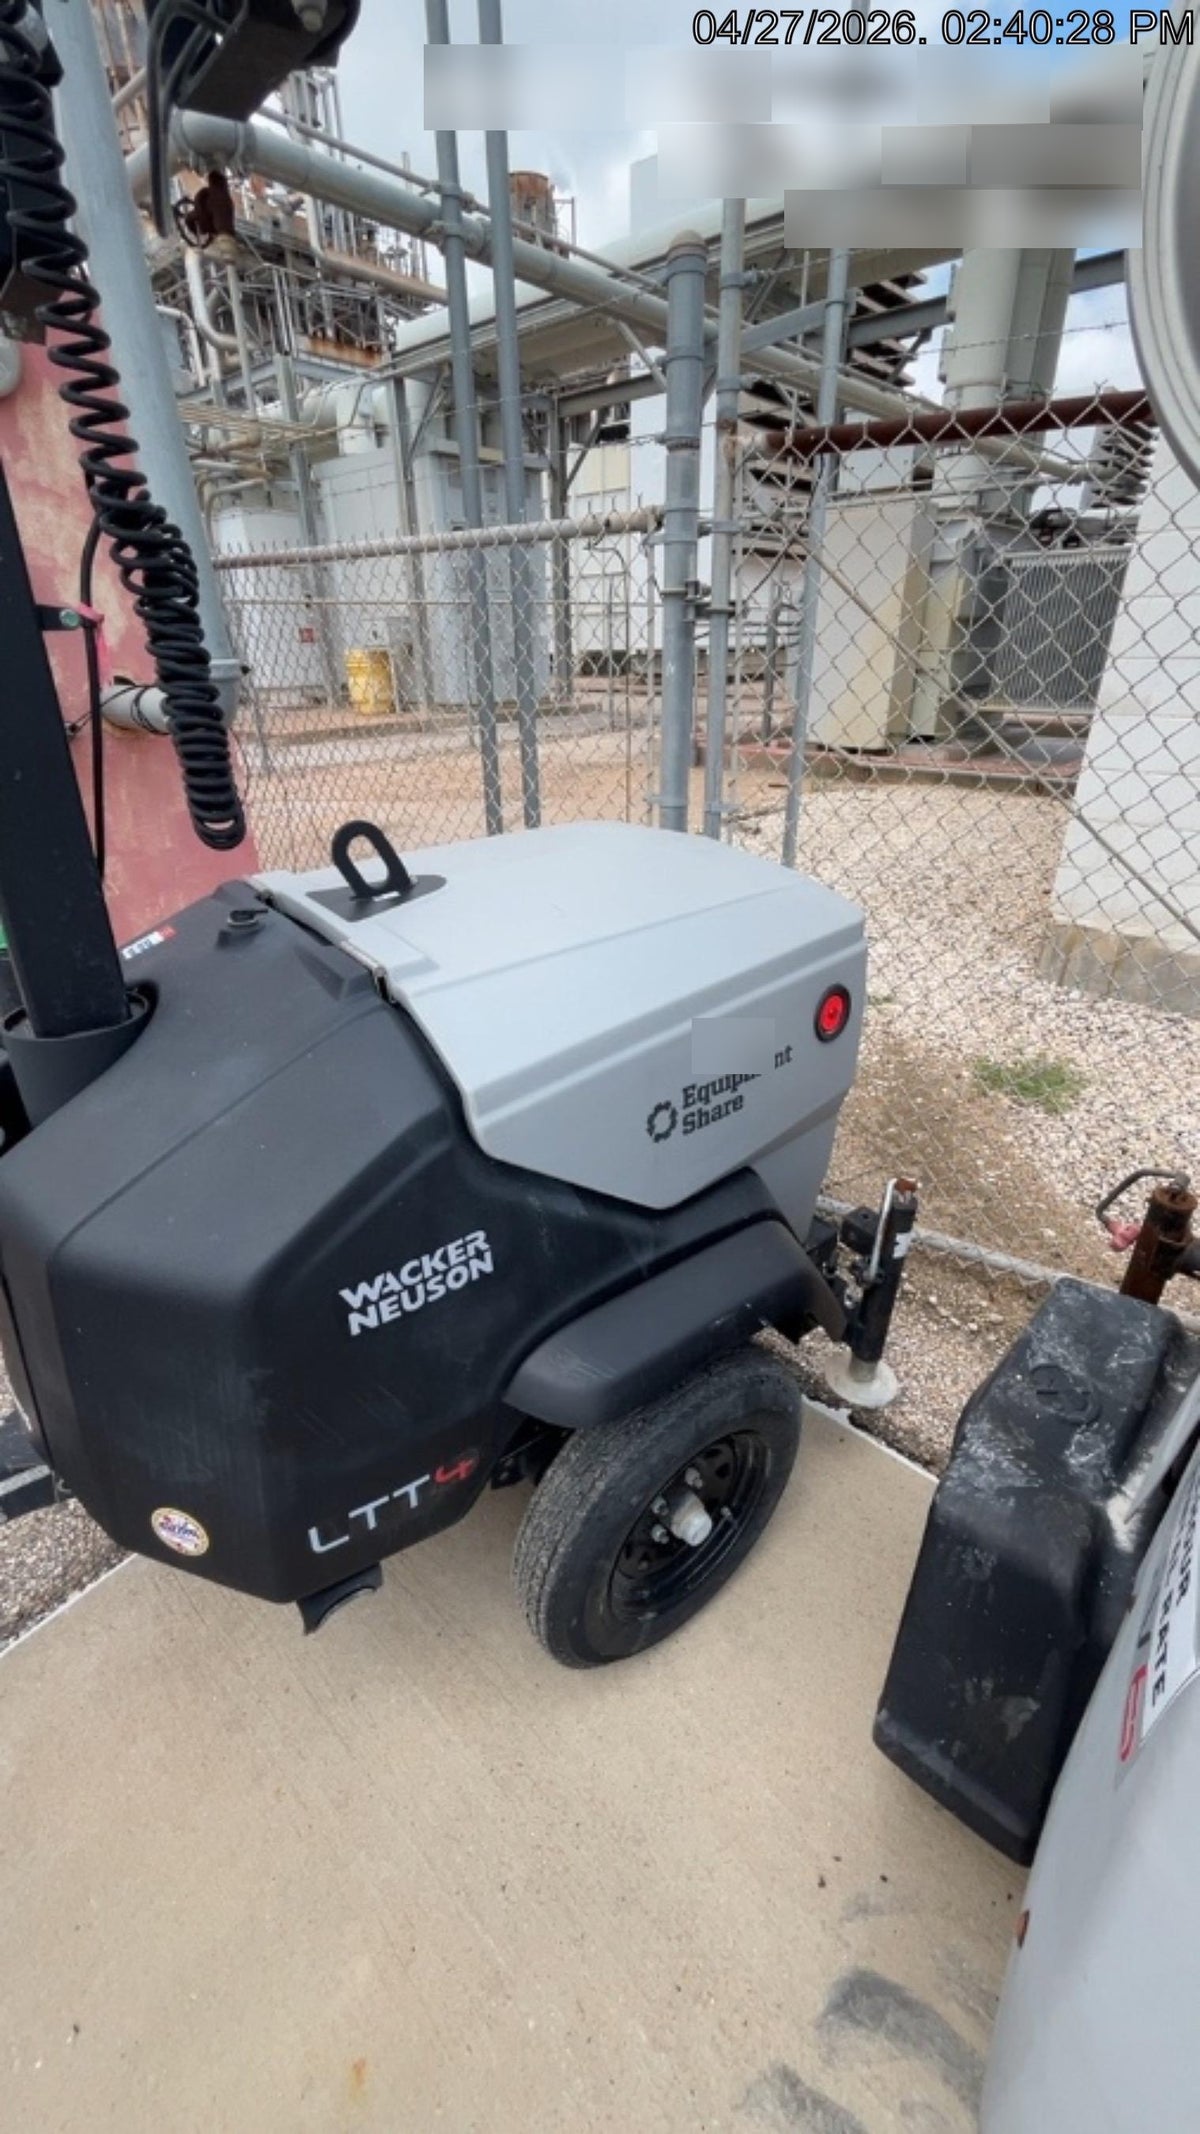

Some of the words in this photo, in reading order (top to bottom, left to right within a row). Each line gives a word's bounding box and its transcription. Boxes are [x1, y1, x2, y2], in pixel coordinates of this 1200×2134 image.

[682, 1094, 745, 1136] Share
[338, 1230, 491, 1310] WACKER
[347, 1251, 494, 1336] NEUSON
